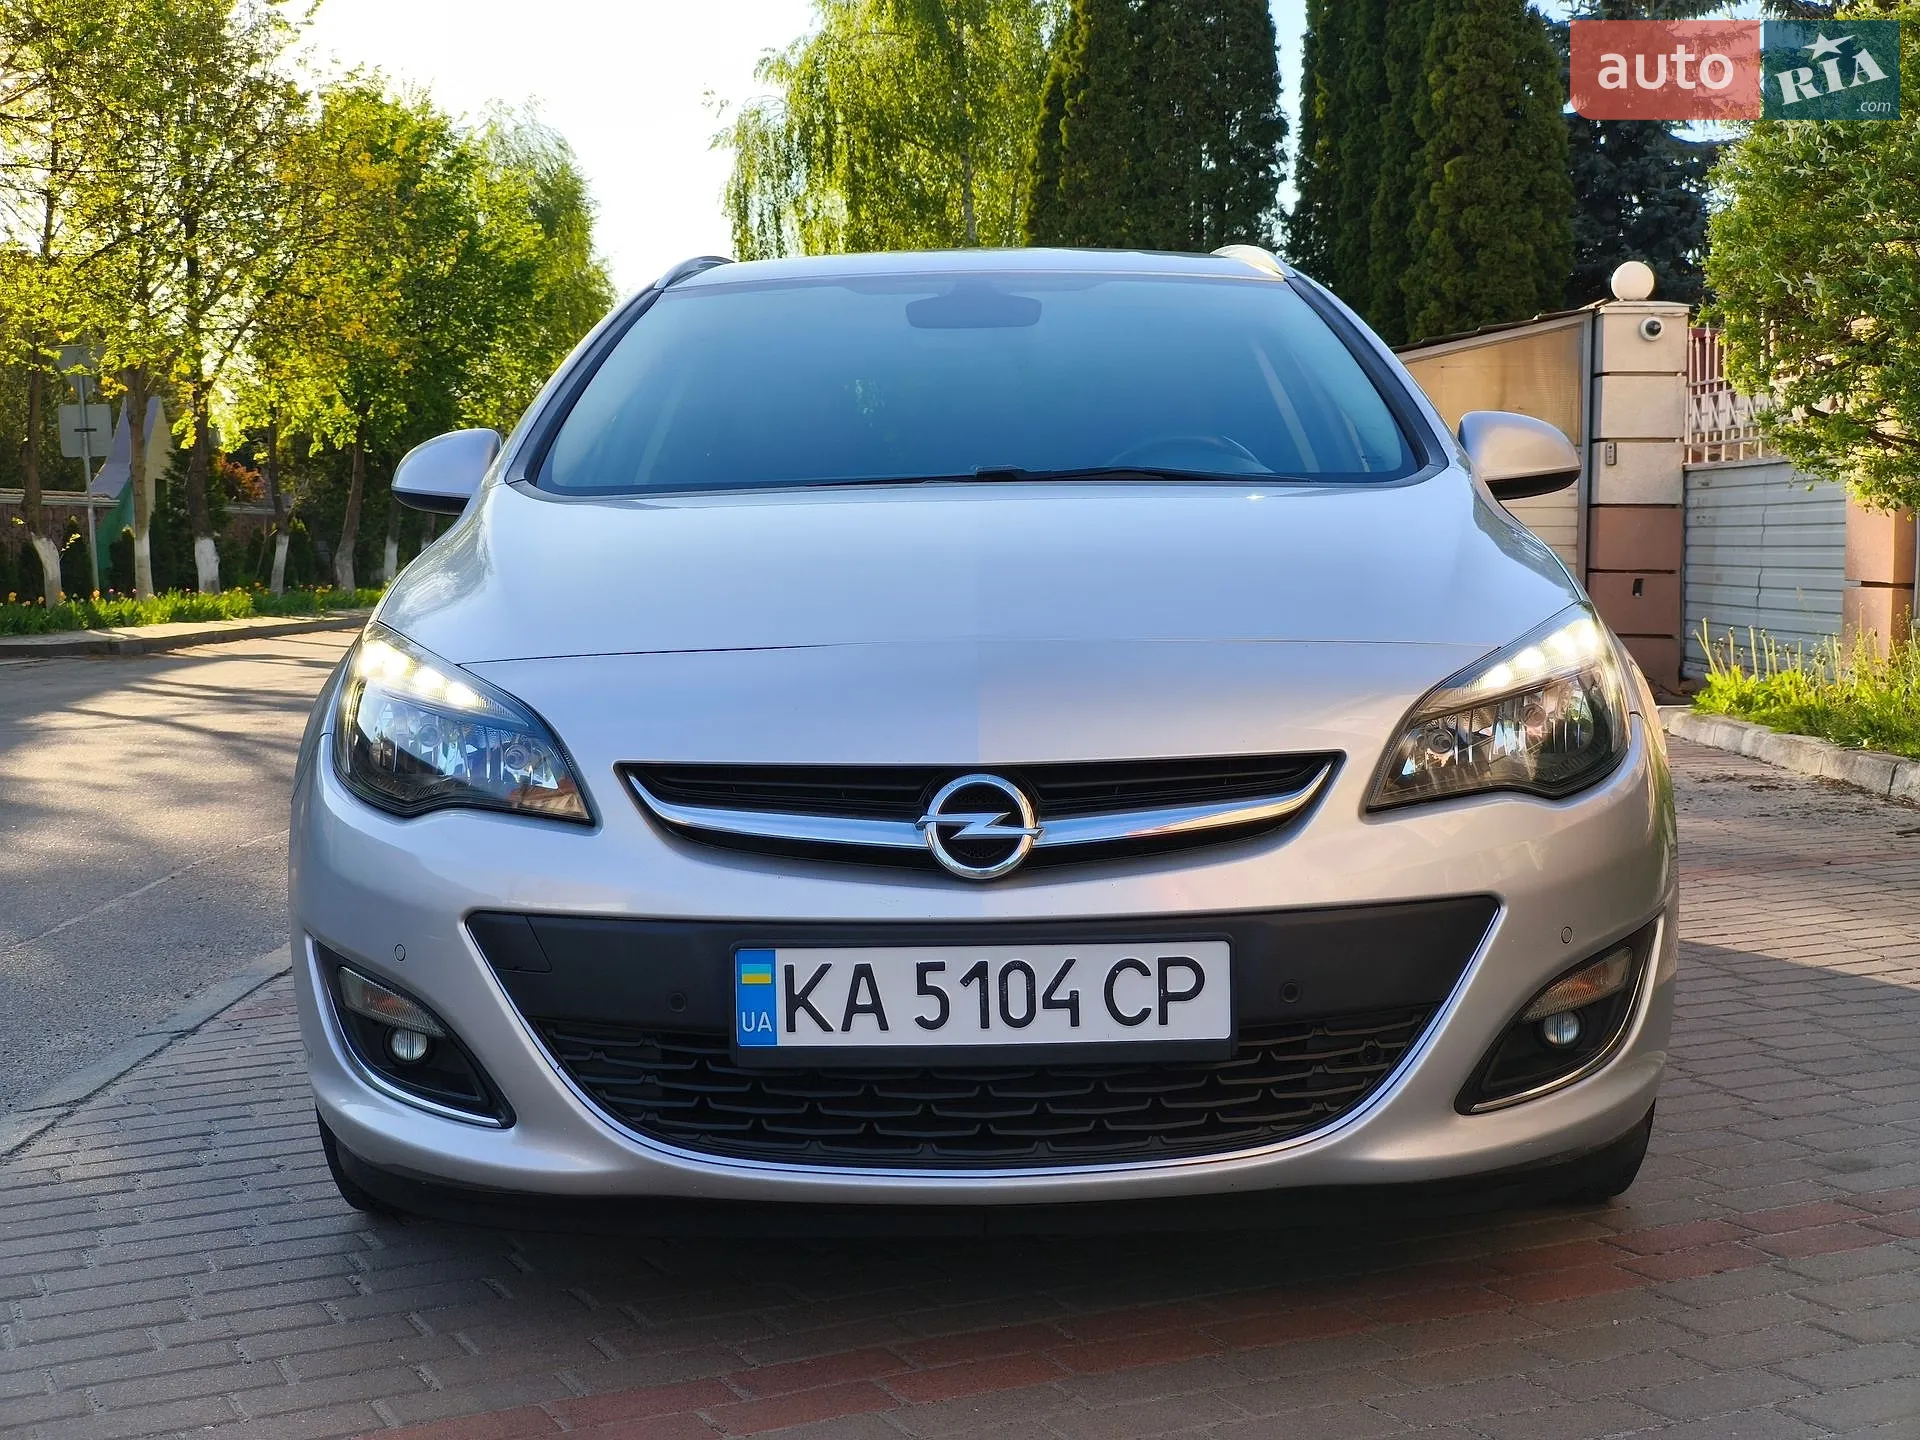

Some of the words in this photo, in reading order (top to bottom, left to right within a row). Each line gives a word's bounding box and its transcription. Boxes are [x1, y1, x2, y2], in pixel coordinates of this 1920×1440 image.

[784, 962, 890, 1033] KA
[914, 958, 1081, 1030] 5104
[1103, 956, 1206, 1027] CP
[742, 1012, 773, 1033] UA
